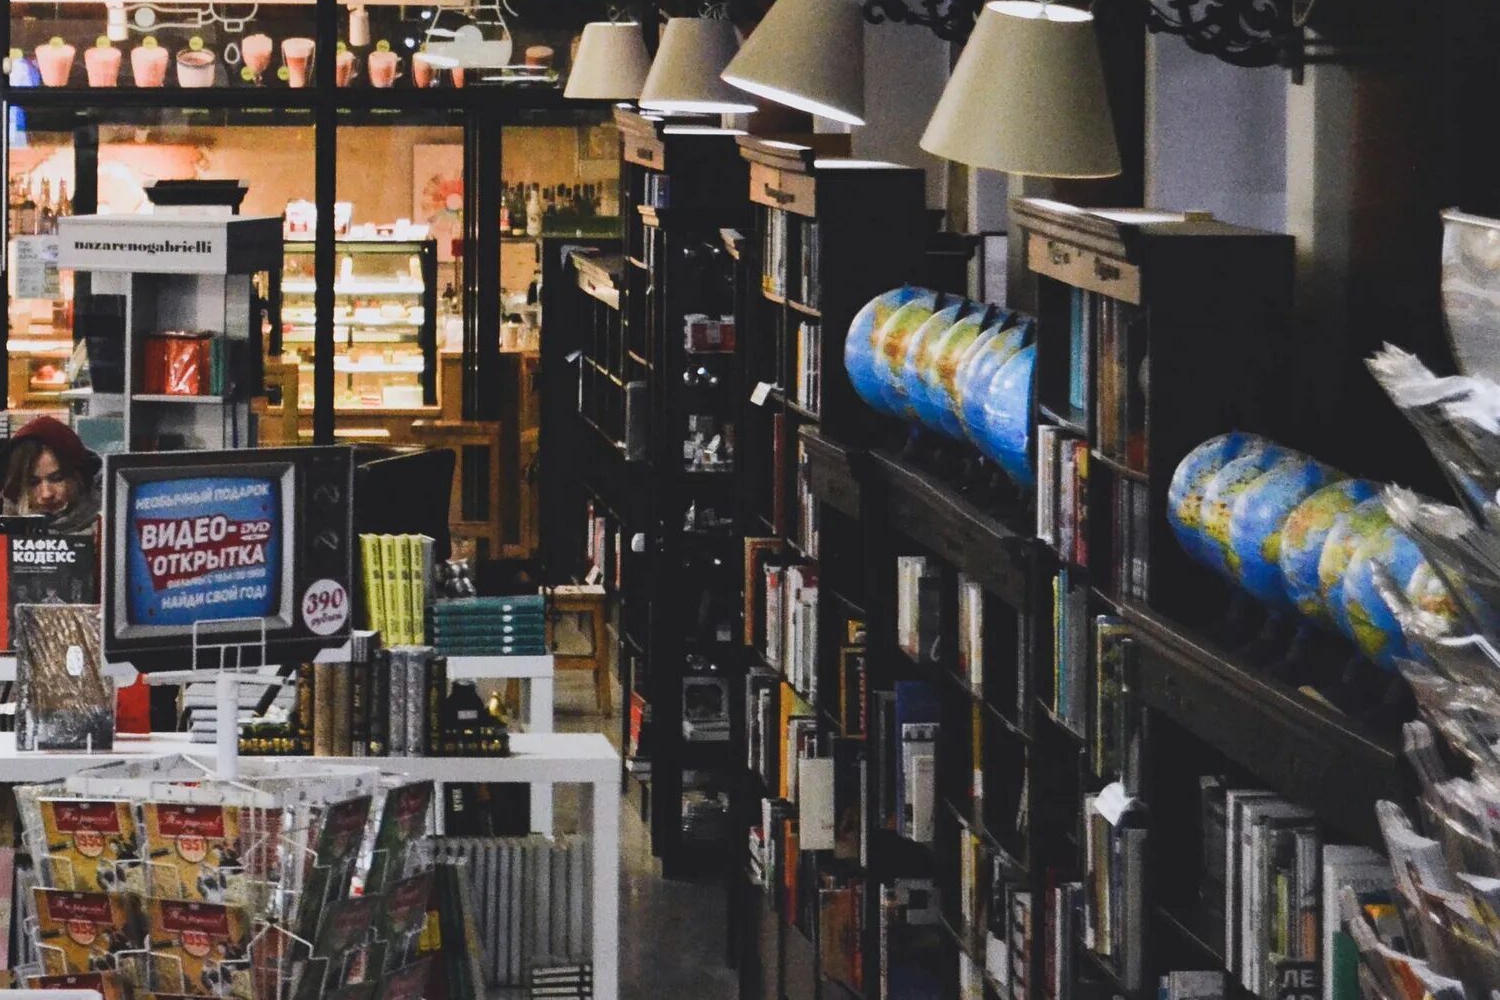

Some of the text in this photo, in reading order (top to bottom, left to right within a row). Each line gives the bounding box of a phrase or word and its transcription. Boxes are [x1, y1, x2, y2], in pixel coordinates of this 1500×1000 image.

[74, 240, 212, 254] nazarenogabrielli
[136, 483, 270, 510] НЕОБЫЧНЫЙ ПОДАРОК
[12, 539, 69, 551] КАФКА
[141, 516, 271, 551] ВИДЕО- DVD
[13, 551, 77, 564] КОДЕКС
[153, 543, 265, 576] ОТКРЫТКА
[161, 585, 267, 610] НАЙДИ СВОЙ ГОД!
[306, 588, 344, 615] 390
[1283, 969, 1316, 988] ЛЕ
